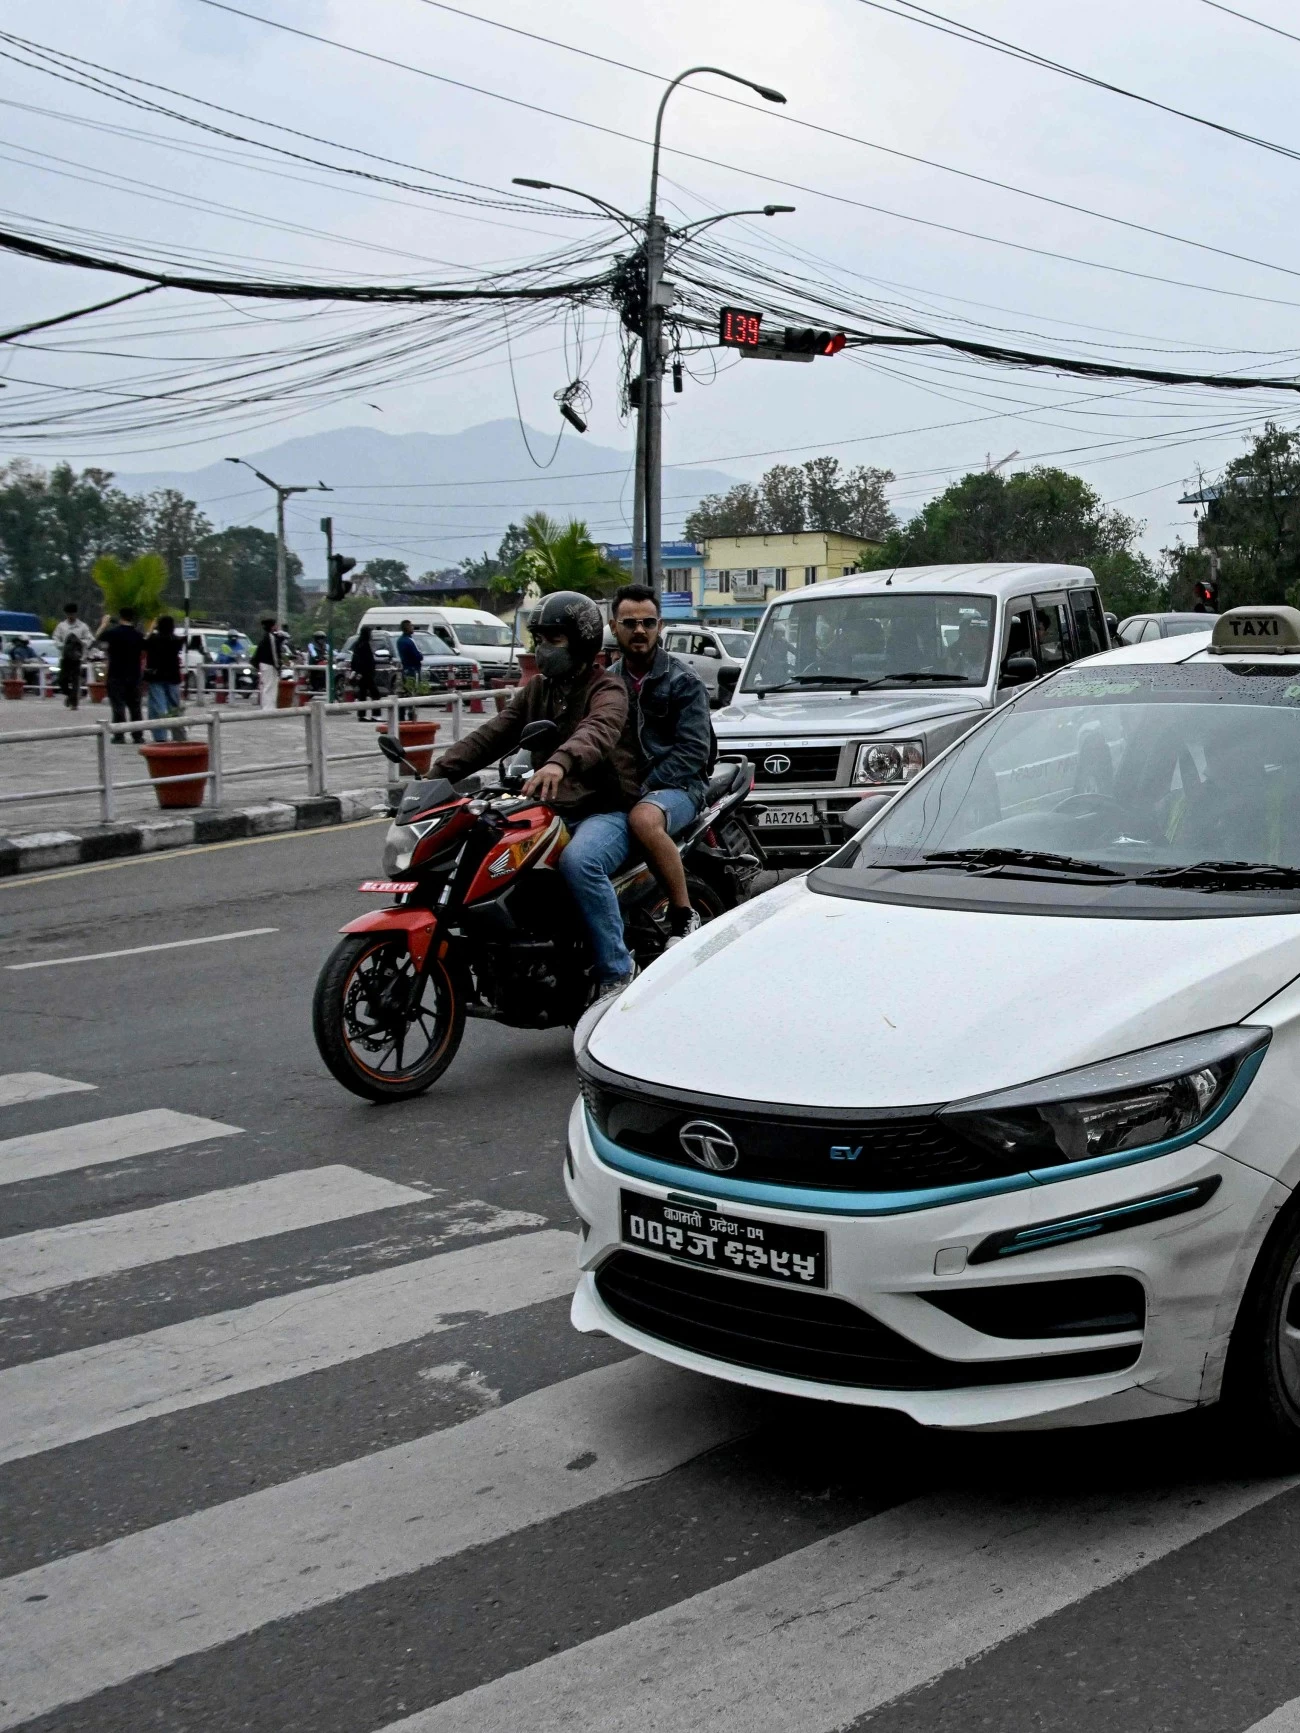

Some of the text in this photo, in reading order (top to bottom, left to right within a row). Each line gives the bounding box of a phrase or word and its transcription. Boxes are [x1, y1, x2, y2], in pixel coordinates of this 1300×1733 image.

[725, 313, 758, 343] 139
[1229, 620, 1278, 635] TAXI
[830, 1145, 863, 1160] EV
[663, 1207, 703, 1228] बागमती
